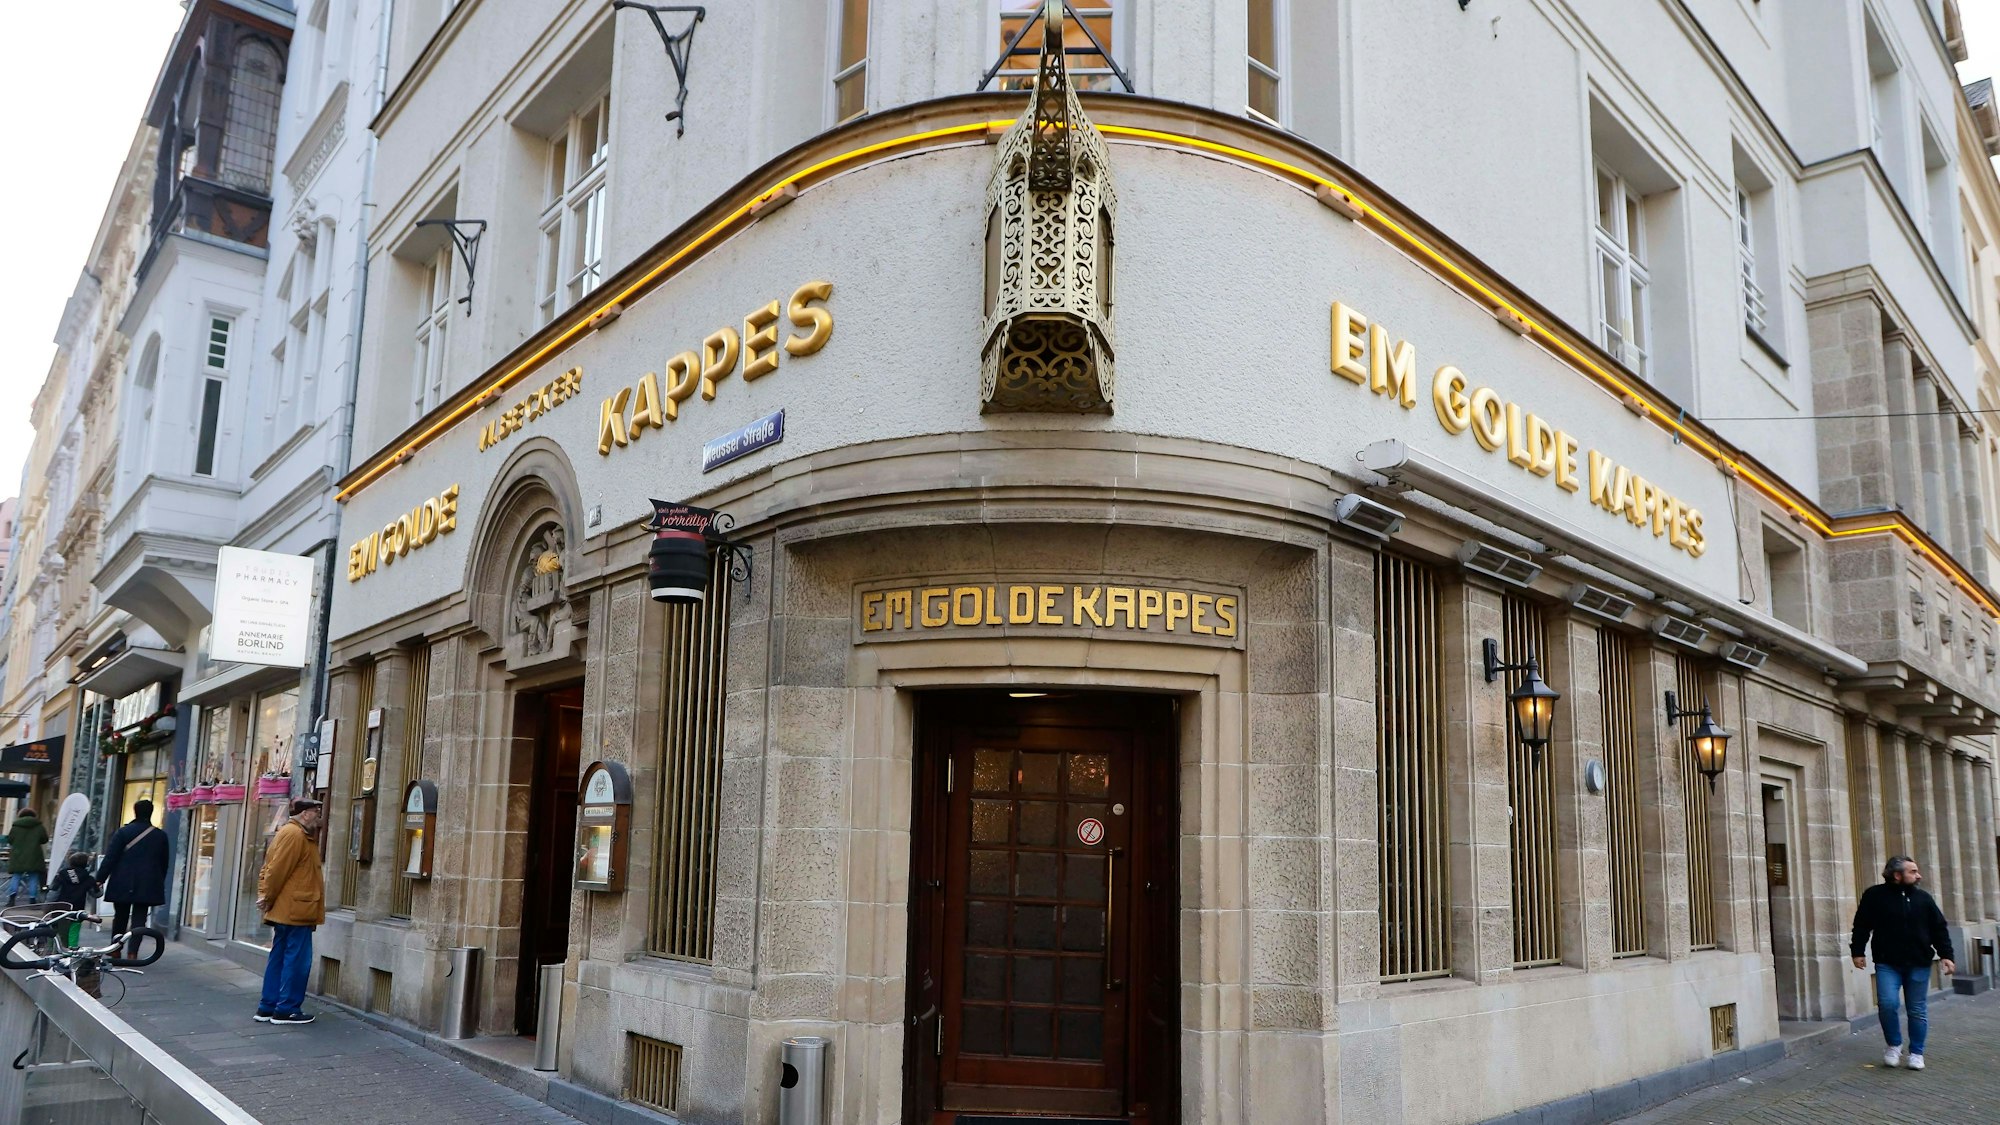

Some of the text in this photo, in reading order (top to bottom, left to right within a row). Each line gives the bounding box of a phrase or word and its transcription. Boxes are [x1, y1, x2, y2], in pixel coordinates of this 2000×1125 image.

[598, 280, 833, 456] KAPPES
[499, 365, 584, 441] BECKER
[1331, 300, 1706, 559] EM GOLDE KAPPES
[742, 420, 775, 447] Straße
[347, 483, 460, 584] EM GOLDE
[662, 513, 714, 533] vorrätig!
[235, 572, 298, 586] PHARMACY
[239, 630, 284, 640] ANNEMARIE
[863, 585, 1237, 638] EM GOLDE KAPPES
